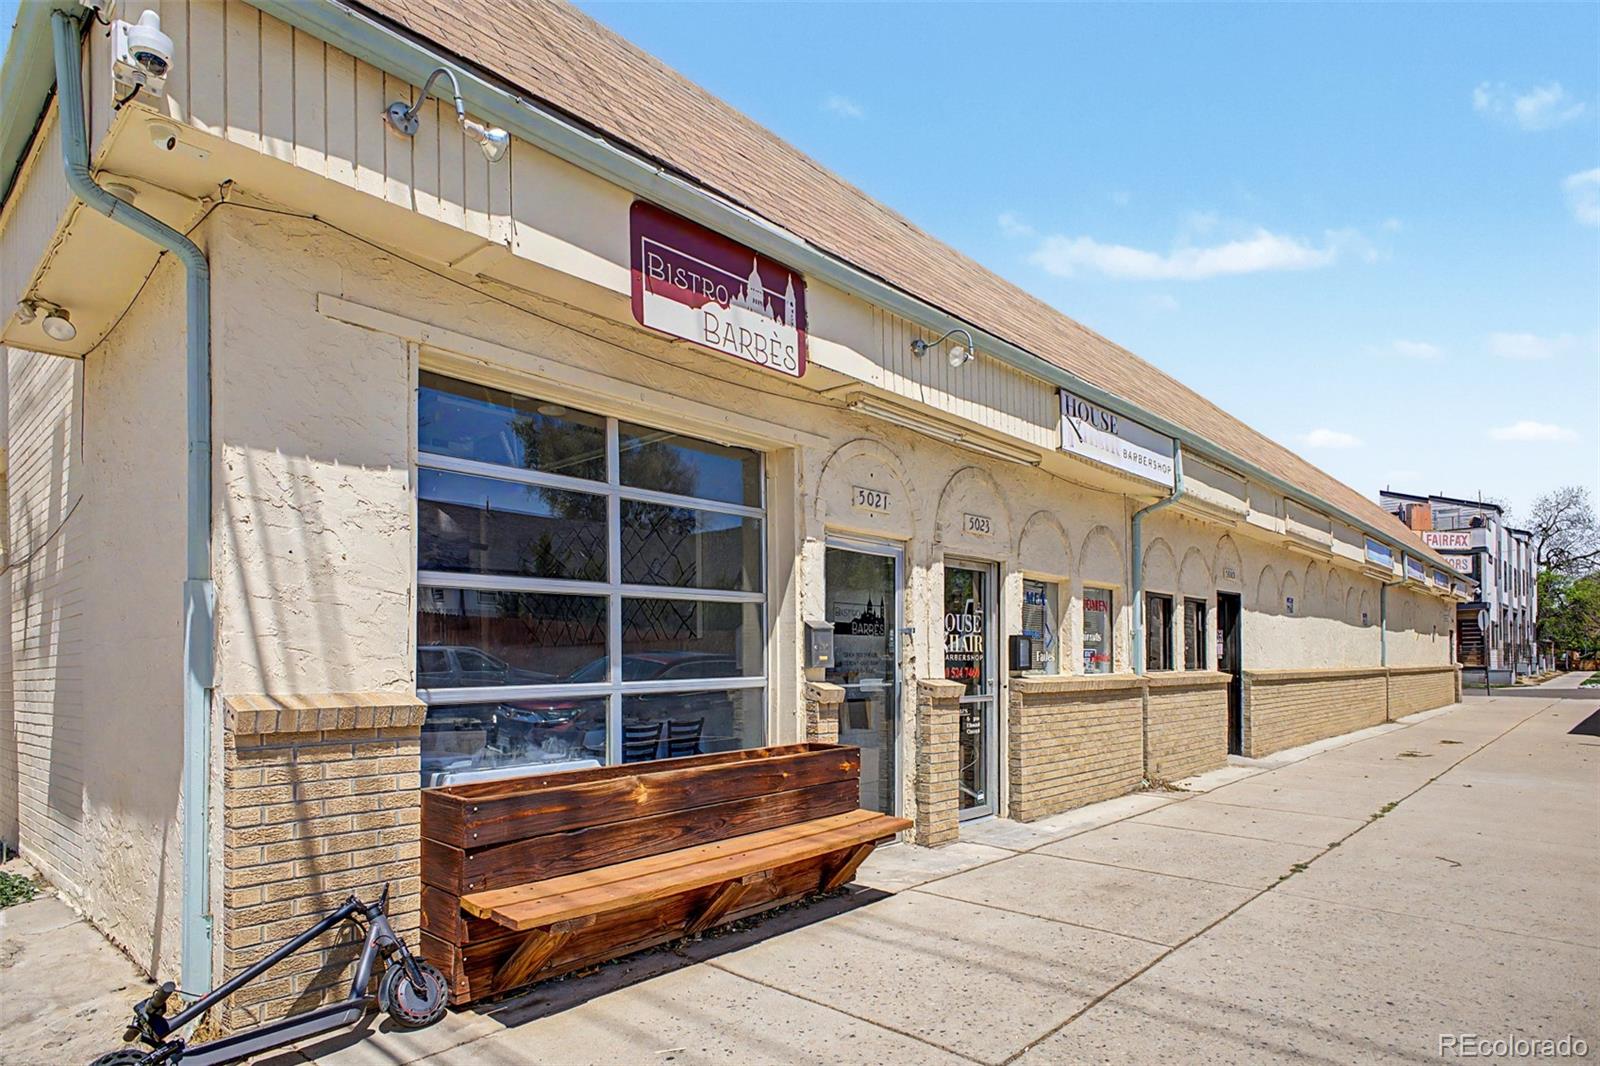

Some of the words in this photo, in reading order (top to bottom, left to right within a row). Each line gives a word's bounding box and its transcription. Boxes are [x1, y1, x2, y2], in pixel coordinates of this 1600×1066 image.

[647, 252, 730, 305] BISTRO
[703, 311, 797, 371] BARBÈS
[1064, 394, 1119, 435] HOUSE
[1122, 448, 1172, 475] BARBERSHOP
[858, 490, 888, 510] 5021
[969, 516, 990, 533] 5023
[1426, 533, 1468, 546] FAIRFAX
[1445, 557, 1469, 570] ORS
[944, 612, 981, 633] OUSE
[945, 653, 984, 661] ARBERSHOP
